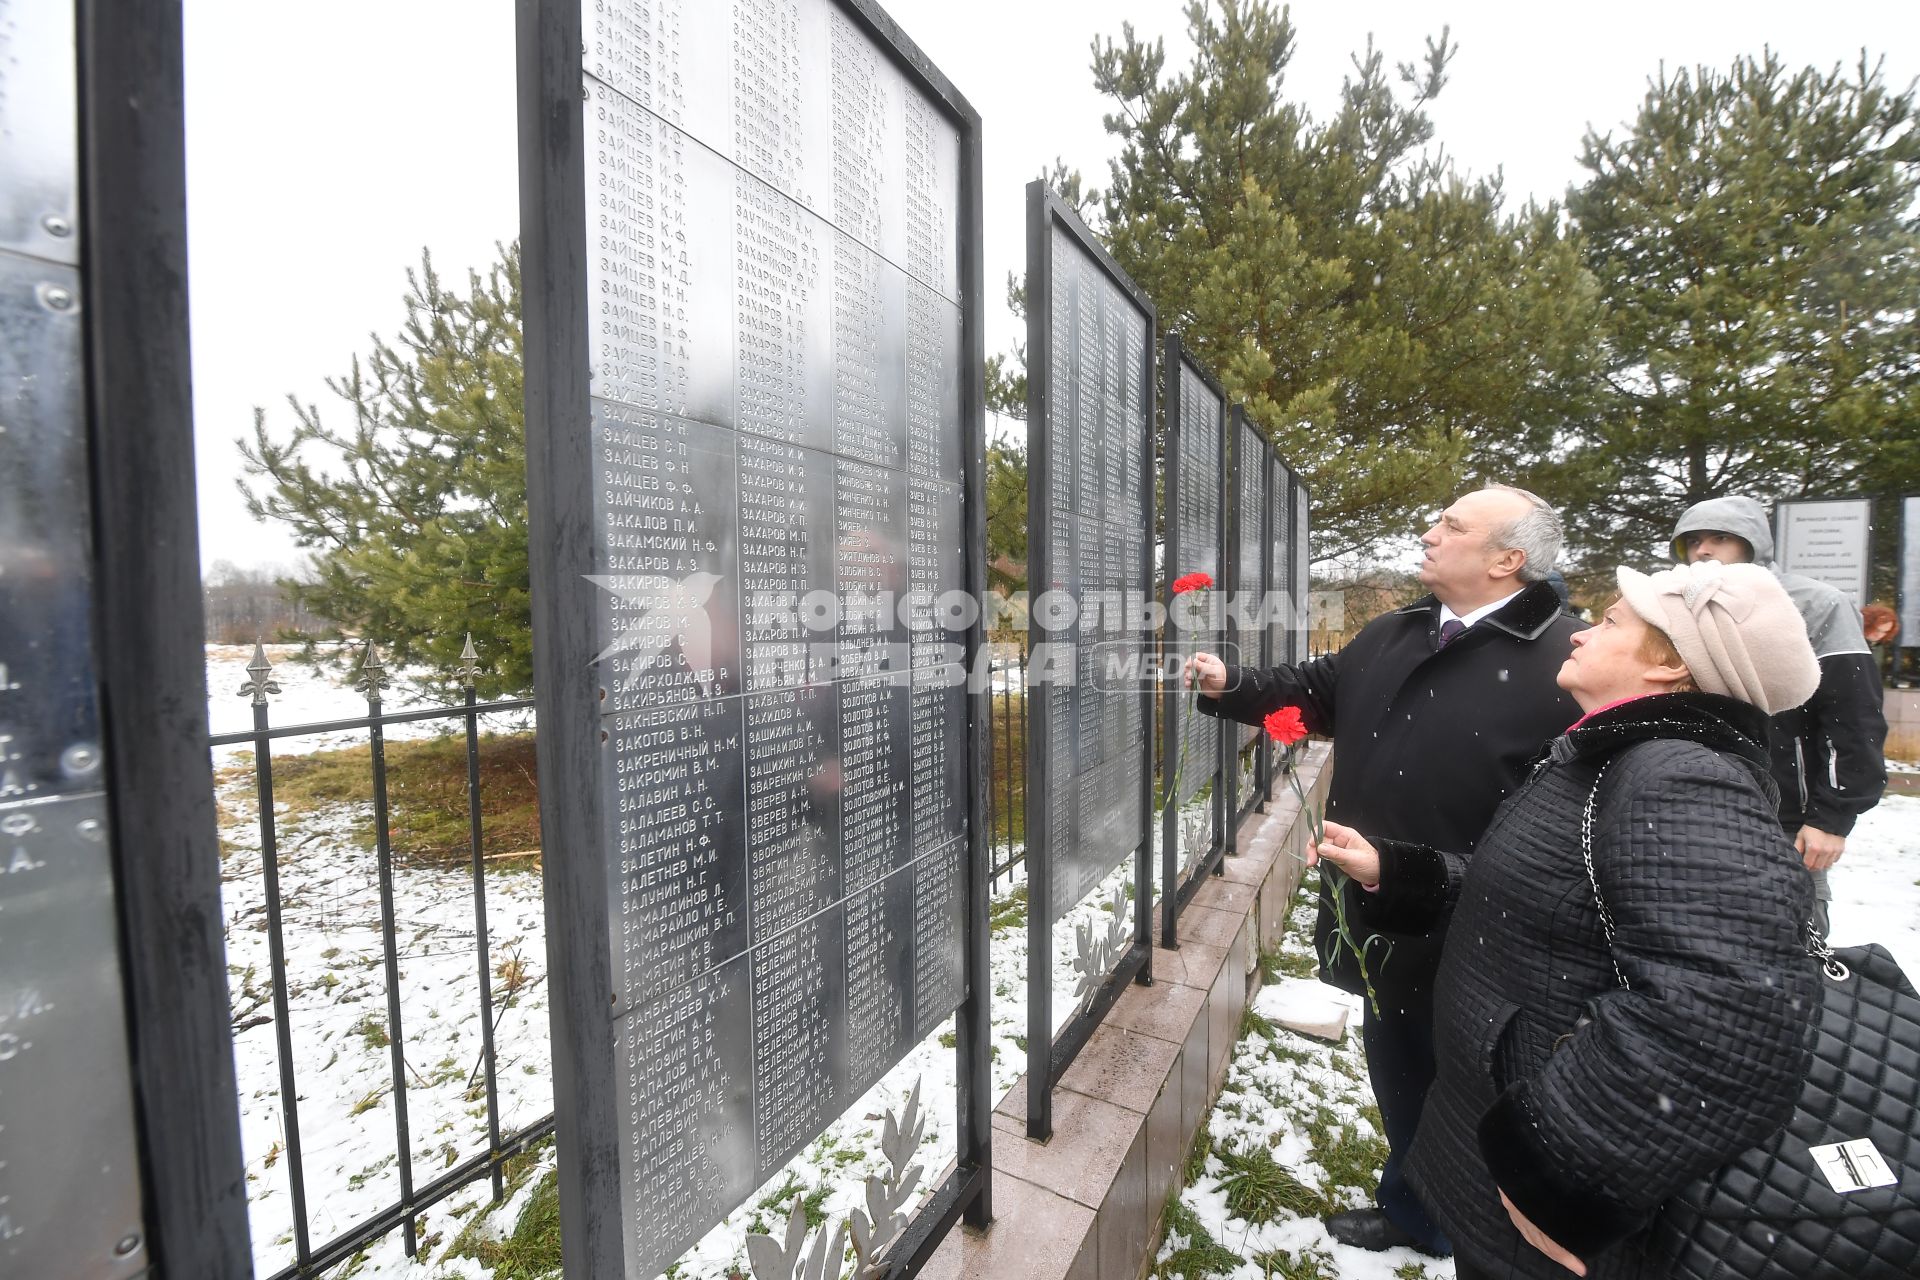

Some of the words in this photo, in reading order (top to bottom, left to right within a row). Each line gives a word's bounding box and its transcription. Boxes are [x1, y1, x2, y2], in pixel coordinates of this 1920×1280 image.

[600, 214, 655, 250] ЗАЙЦЕВ
[601, 257, 655, 290] ЗАЙЦЕВ
[604, 470, 660, 491] ЗАЙЦЕВ
[605, 490, 675, 512] ЗАЙЧИКОВ
[910, 490, 925, 503] ЗУЕВ
[607, 512, 668, 531] ЗАКАЛОВ
[742, 508, 786, 524] ЗАХАРОВ
[607, 532, 687, 551] ЗАКАМСКИЙ
[743, 543, 786, 557] ЗАХАРОВ
[608, 555, 670, 571] ЗАКАРОВ
[744, 561, 787, 575] ЗАХАРОВ
[910, 568, 926, 580] ЗУЕВ
[744, 578, 788, 590] ЗАХАРОВ
[911, 582, 926, 592] ЗУЕВ
[746, 645, 788, 659] ЗАХАРОВ
[613, 668, 715, 693] ЗАКИРХОДЖАЕВ
[746, 659, 806, 677] ЗАХАРЧЕНКО
[614, 686, 697, 711] ЗАКИРЬЯНОВ
[842, 678, 881, 694] ЗОЛОТАРЕВ
[748, 691, 796, 710] ЗАХВАТОВ
[842, 692, 877, 709] ЗОЛОТКОВ
[615, 703, 698, 731] ЗАКНЕВСКИЙ
[748, 707, 792, 726] ЗАХИДОВ
[843, 707, 874, 723] ЗОЛОТОВ
[615, 729, 675, 753] ЗАКОТОВ
[749, 723, 793, 743] ЗАШИХИН
[843, 721, 874, 738] ЗОЛОТОВ
[616, 741, 709, 774] ЗАКРЕНИЧНЫЙ
[750, 755, 795, 778] ЗАЩИХИН
[844, 749, 874, 768] ЗОЛОТОВ
[618, 764, 688, 792] ЗАКРОМИН
[750, 769, 804, 795] ЗВАРЕНКИН
[844, 764, 874, 783] ЗОЛОТОВ
[619, 785, 679, 813] ЗАЛАВИН
[844, 777, 875, 797] ЗОЛОТОВ
[750, 791, 787, 812] ЗВЕРЕВ
[620, 804, 687, 834] ЗАЛАЛЕЕВ
[751, 807, 788, 829] ЗВЕРЕВ
[844, 815, 883, 841] ЗОЛОТУХИН
[620, 819, 697, 854] ЗАЛАМАНОВ
[751, 823, 788, 846] ЗВЕРЕВ
[621, 842, 680, 874] ЗАЛЕТИН
[752, 835, 801, 864] ЗВОРЫКИН
[845, 841, 883, 870] ЗОЛОТУХИН
[621, 859, 688, 895] ЗАЛЕТНЕВ
[753, 863, 807, 896] ЗВЯГИНЦЕВ
[845, 857, 880, 884] ЗОЛОТЦЕВ
[622, 881, 681, 915] ЗАЛУНИН
[623, 889, 708, 935] ЗАМАЛДИНОВ
[754, 898, 796, 929] ЗЕВАКИН
[623, 909, 699, 953] ЗАМАРАЙЛО
[847, 918, 869, 941] ЗОНОВ
[624, 922, 709, 973] ЗАМАРАШКИН
[755, 930, 797, 962] ЗЕЛЕНИН
[847, 941, 878, 969] ЗОРИКОВ
[756, 946, 797, 978] ЗЕЛЕНИН
[756, 961, 798, 995] ЗЕЛЕНИН
[757, 974, 803, 1011] ЗЕЛЕНКИН
[627, 985, 692, 1030] ЗАНБАРОВ
[757, 990, 804, 1028] ЗЕЛЕНКОВ
[628, 998, 703, 1049] ЗАНДЕЛЕЕВ
[757, 1008, 798, 1044] ЗЕЛЕНОВ
[629, 1024, 686, 1068] ЗАНЕГИН
[758, 1024, 799, 1060] ЗЕЛЕНОВ
[630, 1042, 687, 1088] ЗАНОЗИН
[630, 1061, 687, 1106] ЗАПАЛОВ
[632, 1089, 703, 1146] ЗАПЕВАЛОВ
[634, 1138, 684, 1183] ЗАПШЕВ
